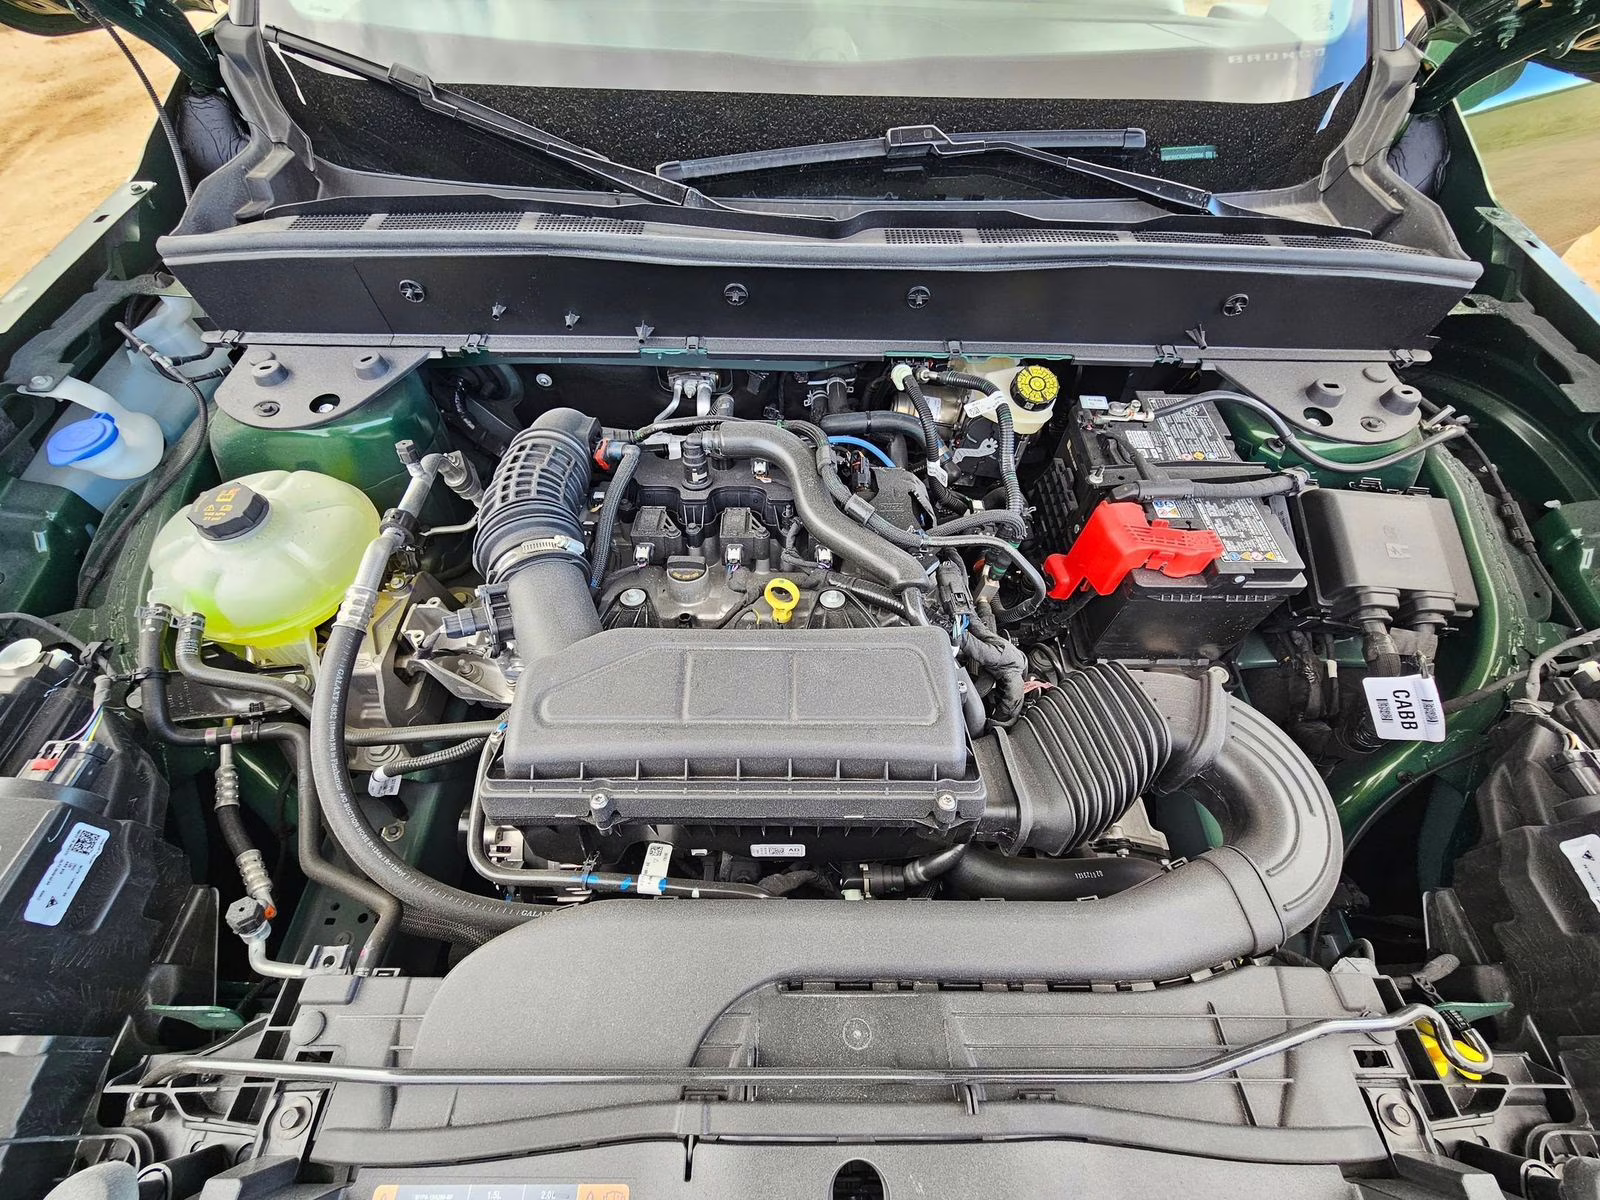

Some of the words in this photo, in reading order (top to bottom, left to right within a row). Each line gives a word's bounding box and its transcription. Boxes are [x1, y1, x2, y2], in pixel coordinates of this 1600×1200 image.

[333, 669, 344, 702] GALAXY
[344, 802, 360, 828] SUCTION
[356, 825, 370, 843] HOSE
[1393, 690, 1418, 729] CABB
